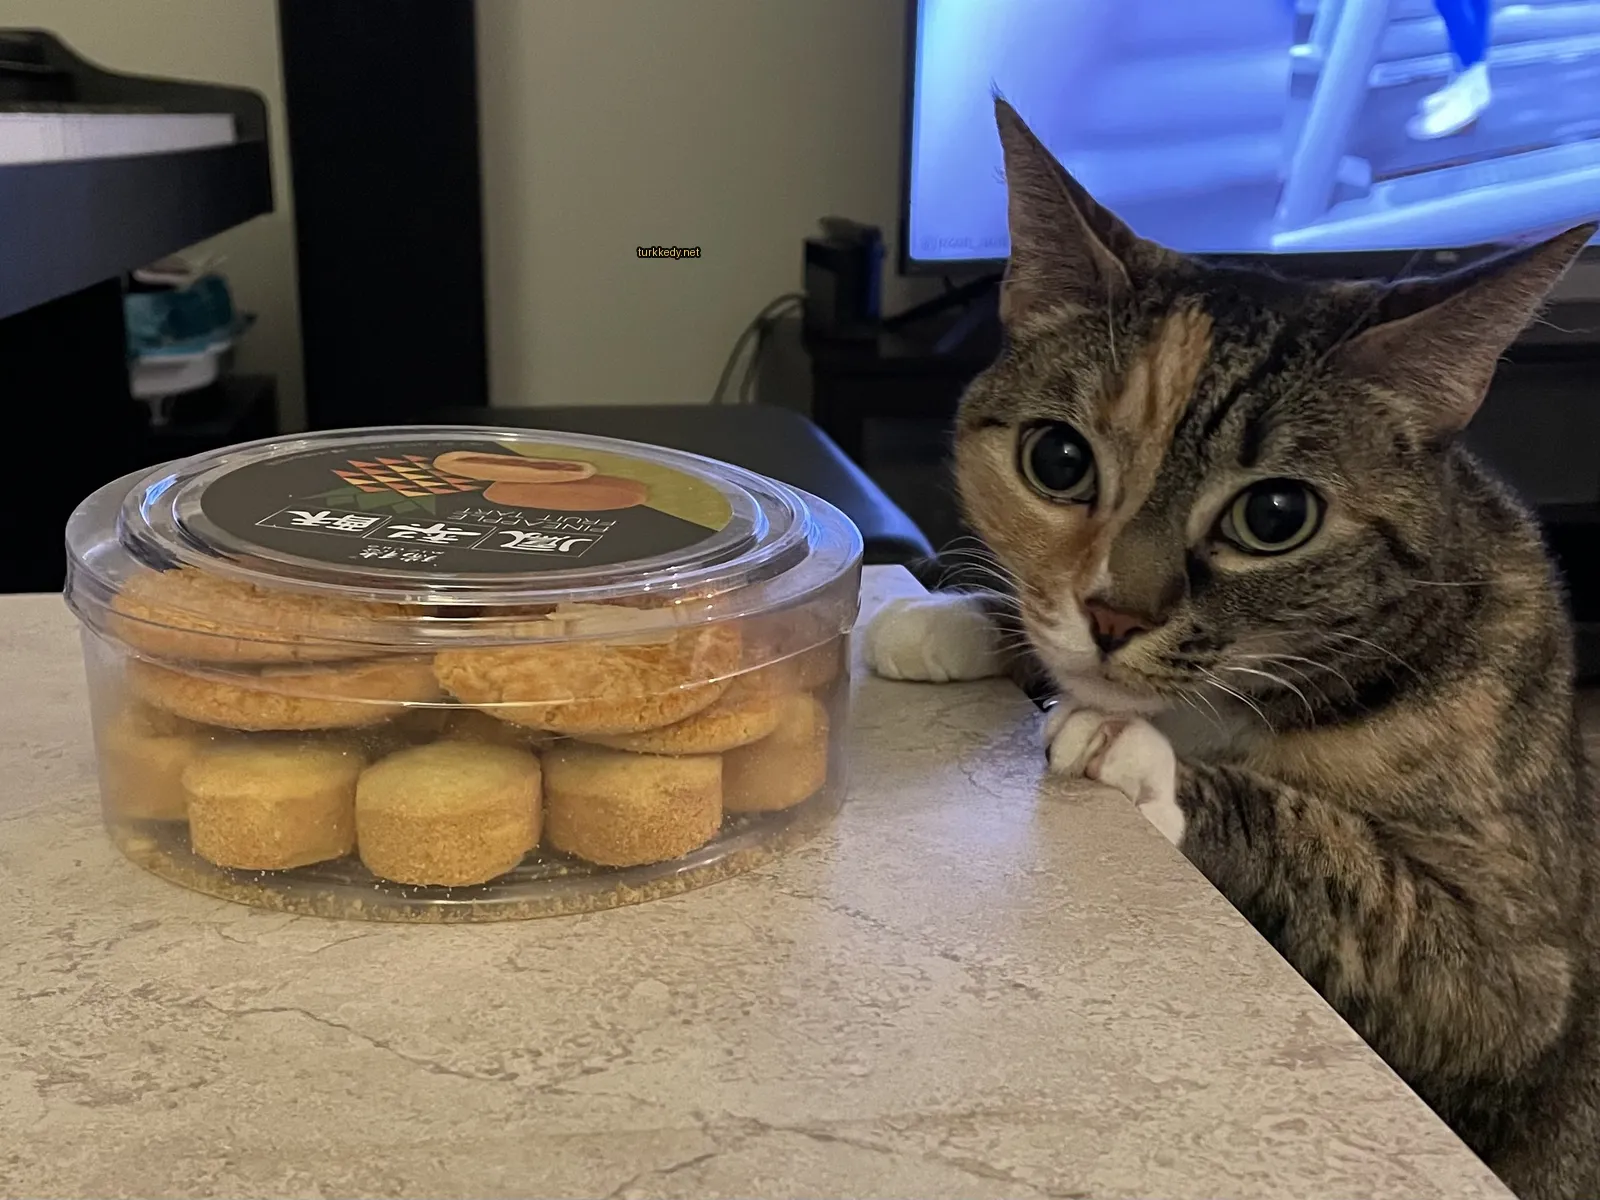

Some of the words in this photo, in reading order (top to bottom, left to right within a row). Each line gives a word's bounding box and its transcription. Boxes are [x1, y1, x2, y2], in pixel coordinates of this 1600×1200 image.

[453, 507, 523, 518] TART
[536, 514, 617, 525] FRUIT
[447, 513, 609, 533] PINEAPPLE
[286, 510, 593, 552] 鳳梨酥
